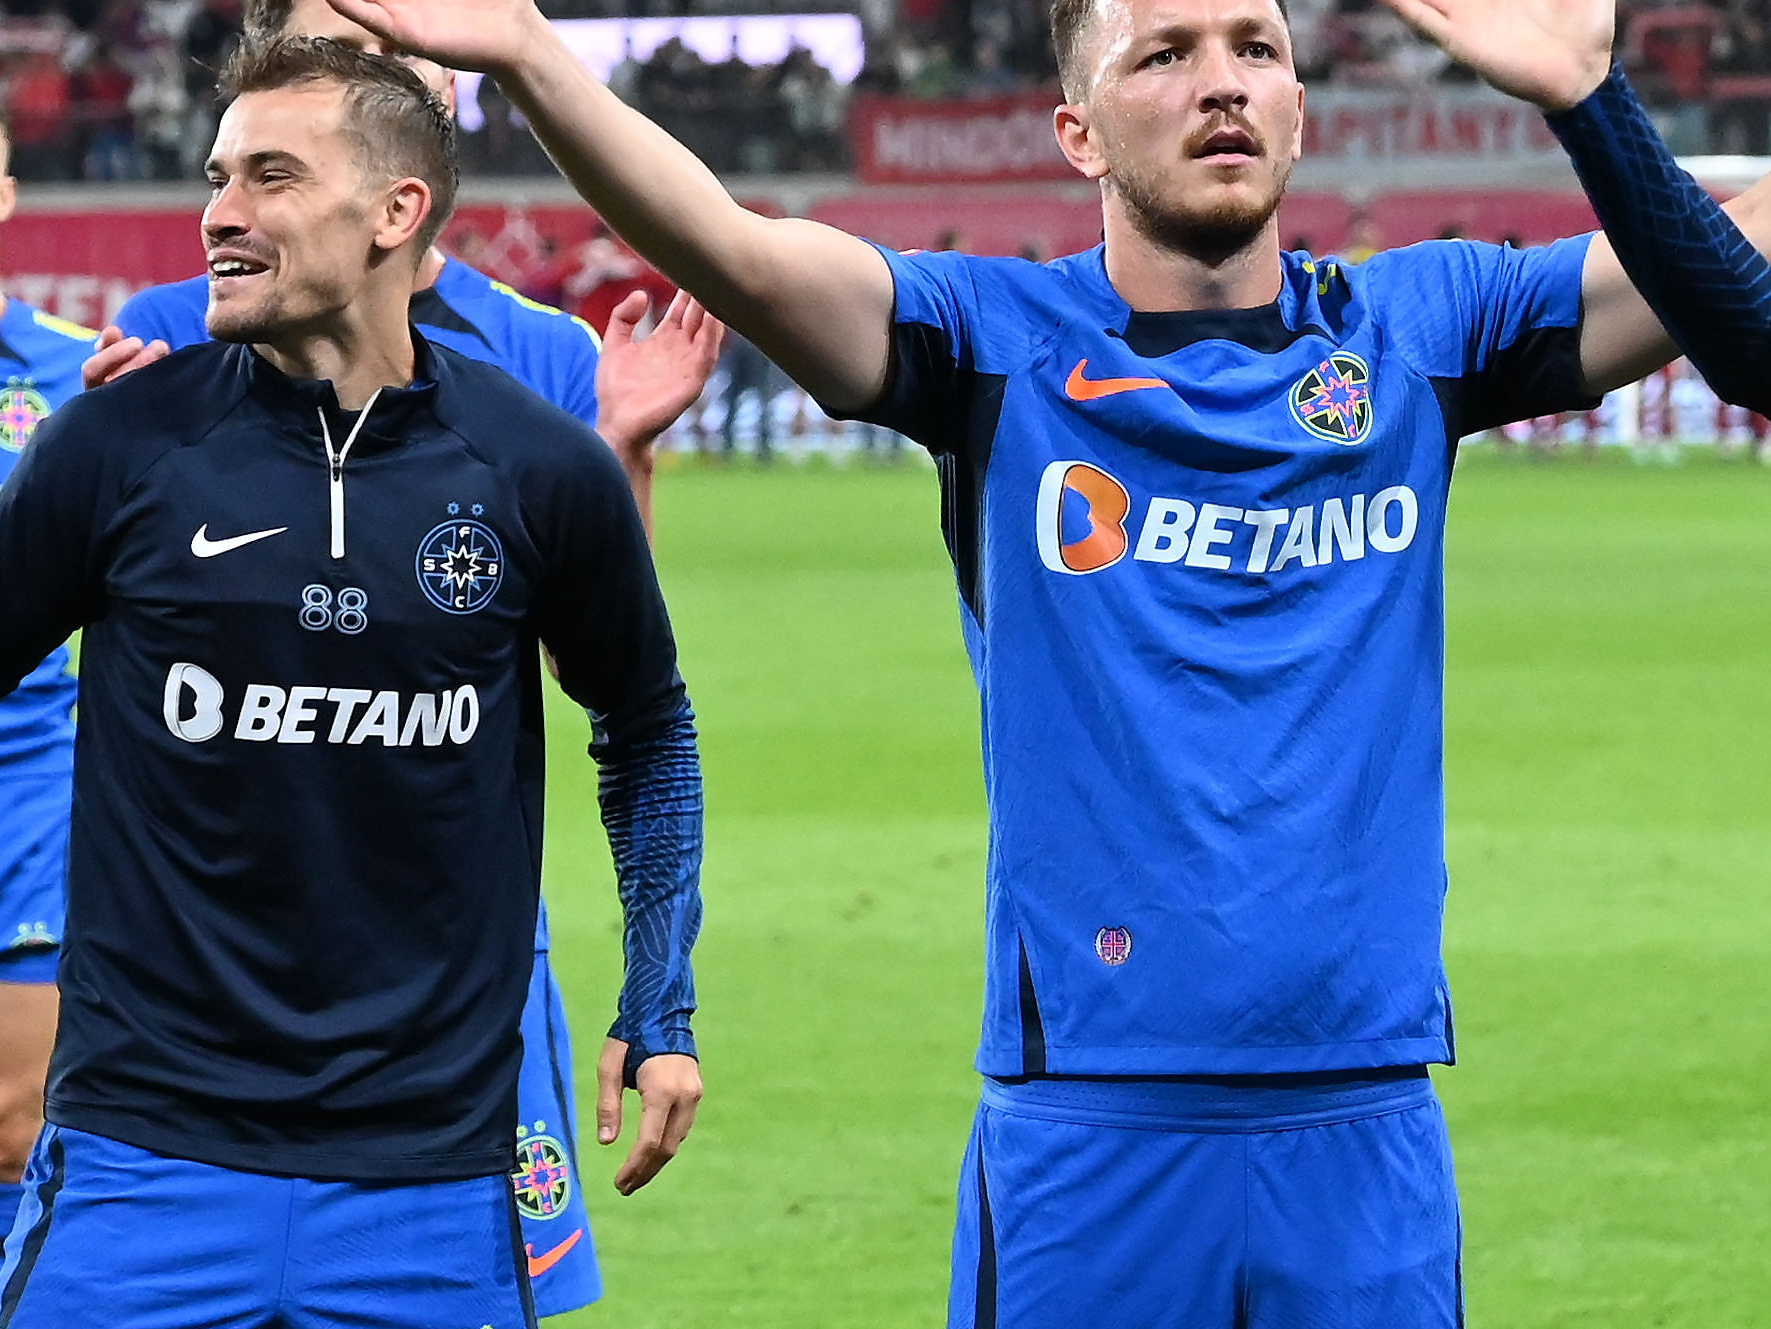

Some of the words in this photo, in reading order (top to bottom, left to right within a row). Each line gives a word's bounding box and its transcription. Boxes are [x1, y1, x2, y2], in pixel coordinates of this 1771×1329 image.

[1134, 485, 1418, 573] BETANO
[298, 583, 368, 634] 88
[234, 684, 479, 747] BETANO
